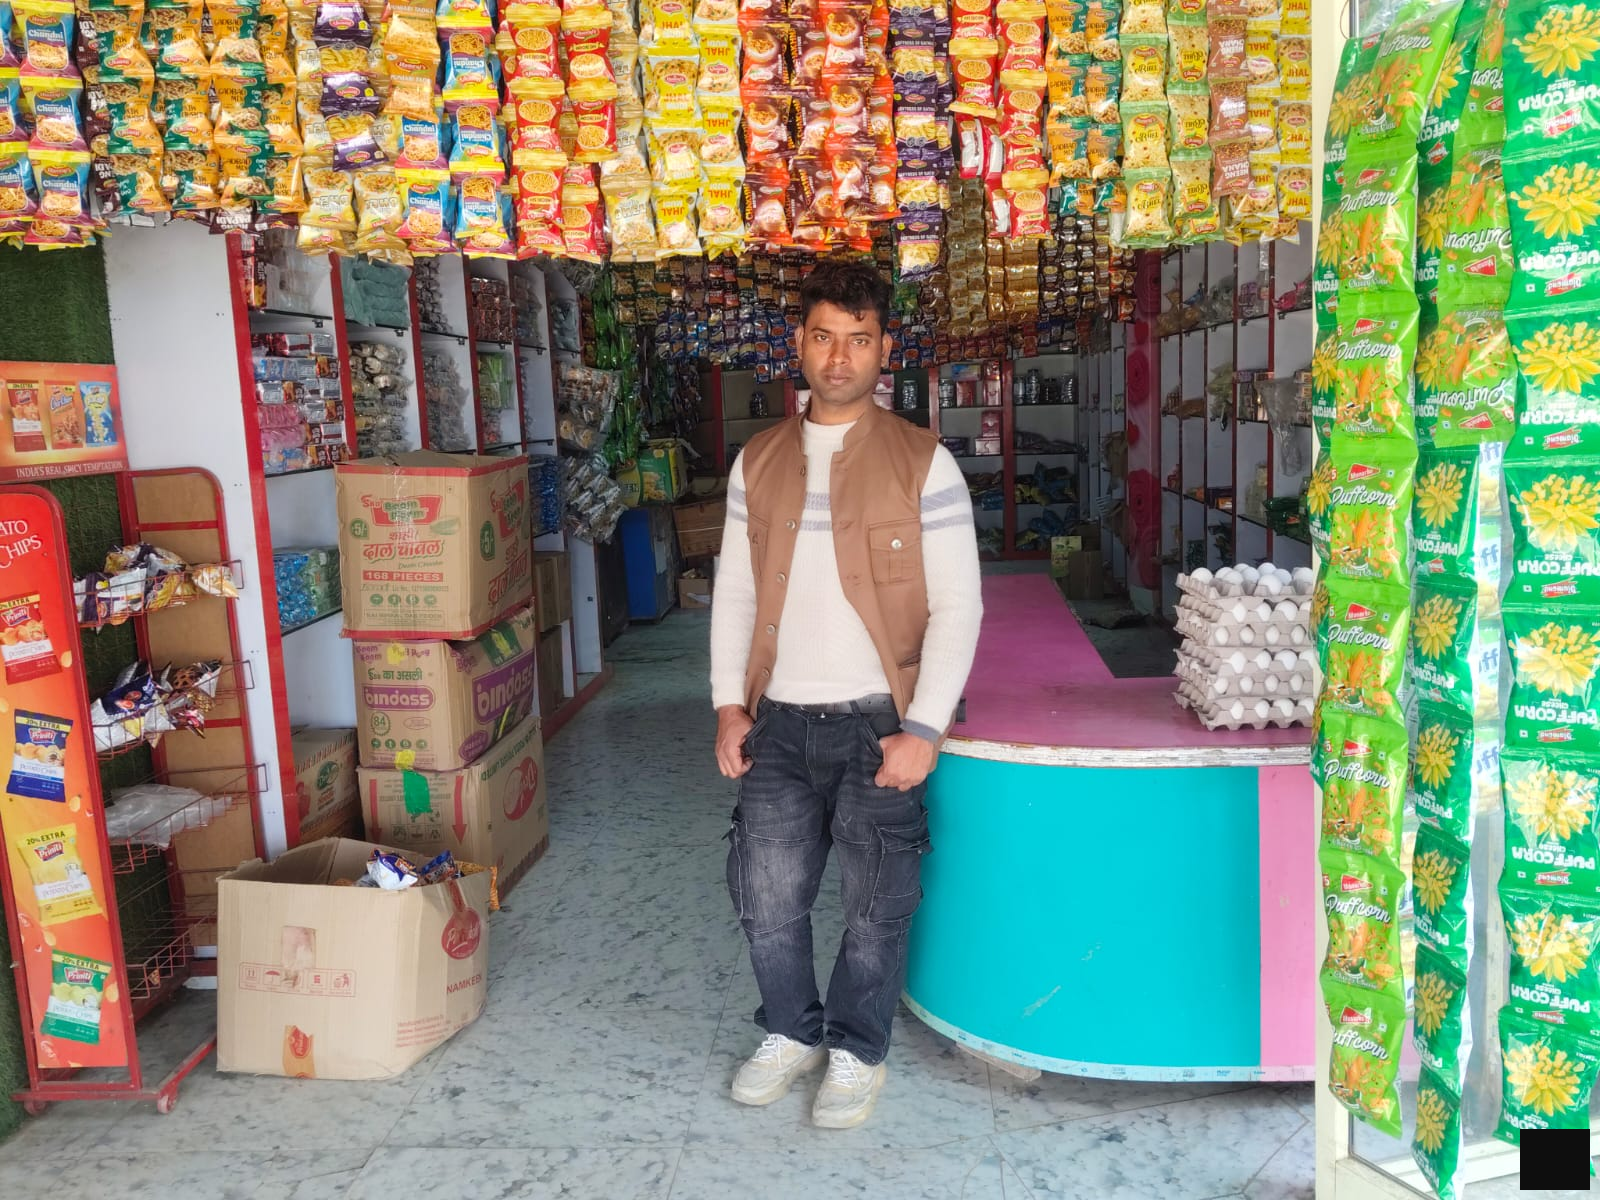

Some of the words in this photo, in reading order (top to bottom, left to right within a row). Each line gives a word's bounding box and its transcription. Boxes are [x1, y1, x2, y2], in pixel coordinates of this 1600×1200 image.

[1287, 1, 1308, 11] JHAL
[28, 29, 63, 40] Chandni
[705, 46, 731, 56] JHAL
[1249, 42, 1271, 51] JHAL
[1287, 68, 1309, 77] JHAL
[37, 104, 72, 114] Chandni
[404, 124, 435, 132] Chandni
[706, 118, 731, 128] JHAL
[42, 179, 78, 190] Chandni
[708, 188, 733, 198] JHAL
[410, 197, 440, 206] Chandni
[1286, 197, 1308, 207] JHAL
[1438, 377, 1508, 409] Puffcorn
[16, 467, 44, 478] INDIA'S
[45, 465, 61, 476] REAL
[63, 464, 81, 475] SPICY
[83, 461, 124, 472] TEMPTATION
[1330, 485, 1397, 507] Puffcorn
[366, 571, 389, 580] 168
[392, 572, 441, 582] PIECES
[1327, 624, 1392, 651] Puffcorn
[364, 687, 430, 706] bindass
[373, 715, 386, 727] 84
[1324, 760, 1390, 789] Puffcorn
[40, 831, 66, 842] EXTRA
[1326, 894, 1391, 924] Puffcorn
[76, 960, 100, 970] EXTRA
